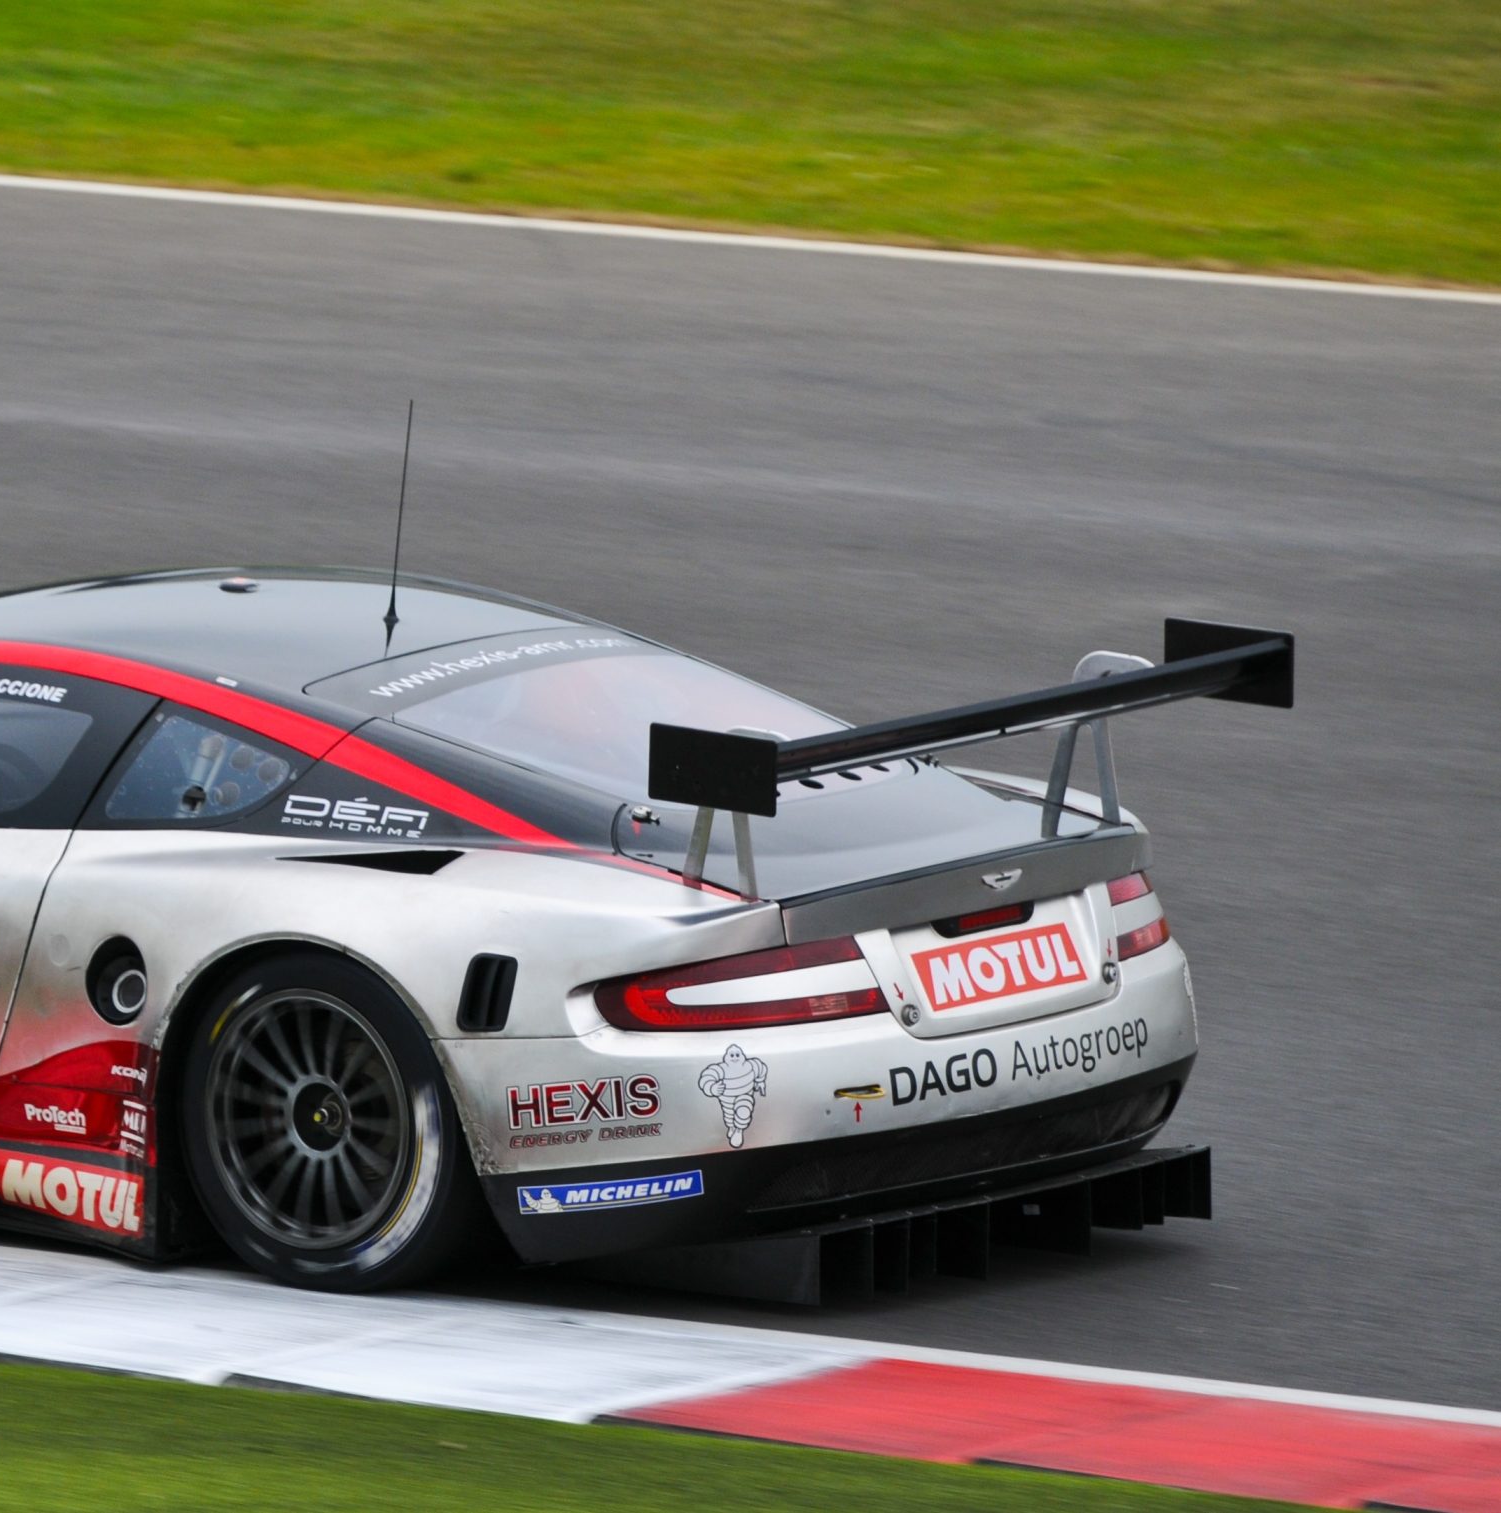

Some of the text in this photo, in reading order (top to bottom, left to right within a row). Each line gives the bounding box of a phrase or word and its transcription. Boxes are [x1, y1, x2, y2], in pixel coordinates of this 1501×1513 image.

[284, 794, 430, 831] DÉFI
[328, 820, 422, 839] HOMME
[928, 932, 1081, 1007] MOTUL
[888, 1016, 1149, 1107] DAGO Autogroep
[24, 1103, 87, 1127] ProTech
[506, 1073, 661, 1131] HEXIS
[509, 1122, 664, 1150] ENERGY DRINK
[1, 1158, 140, 1232] MOTUL
[565, 1176, 695, 1206] MICHELIN
